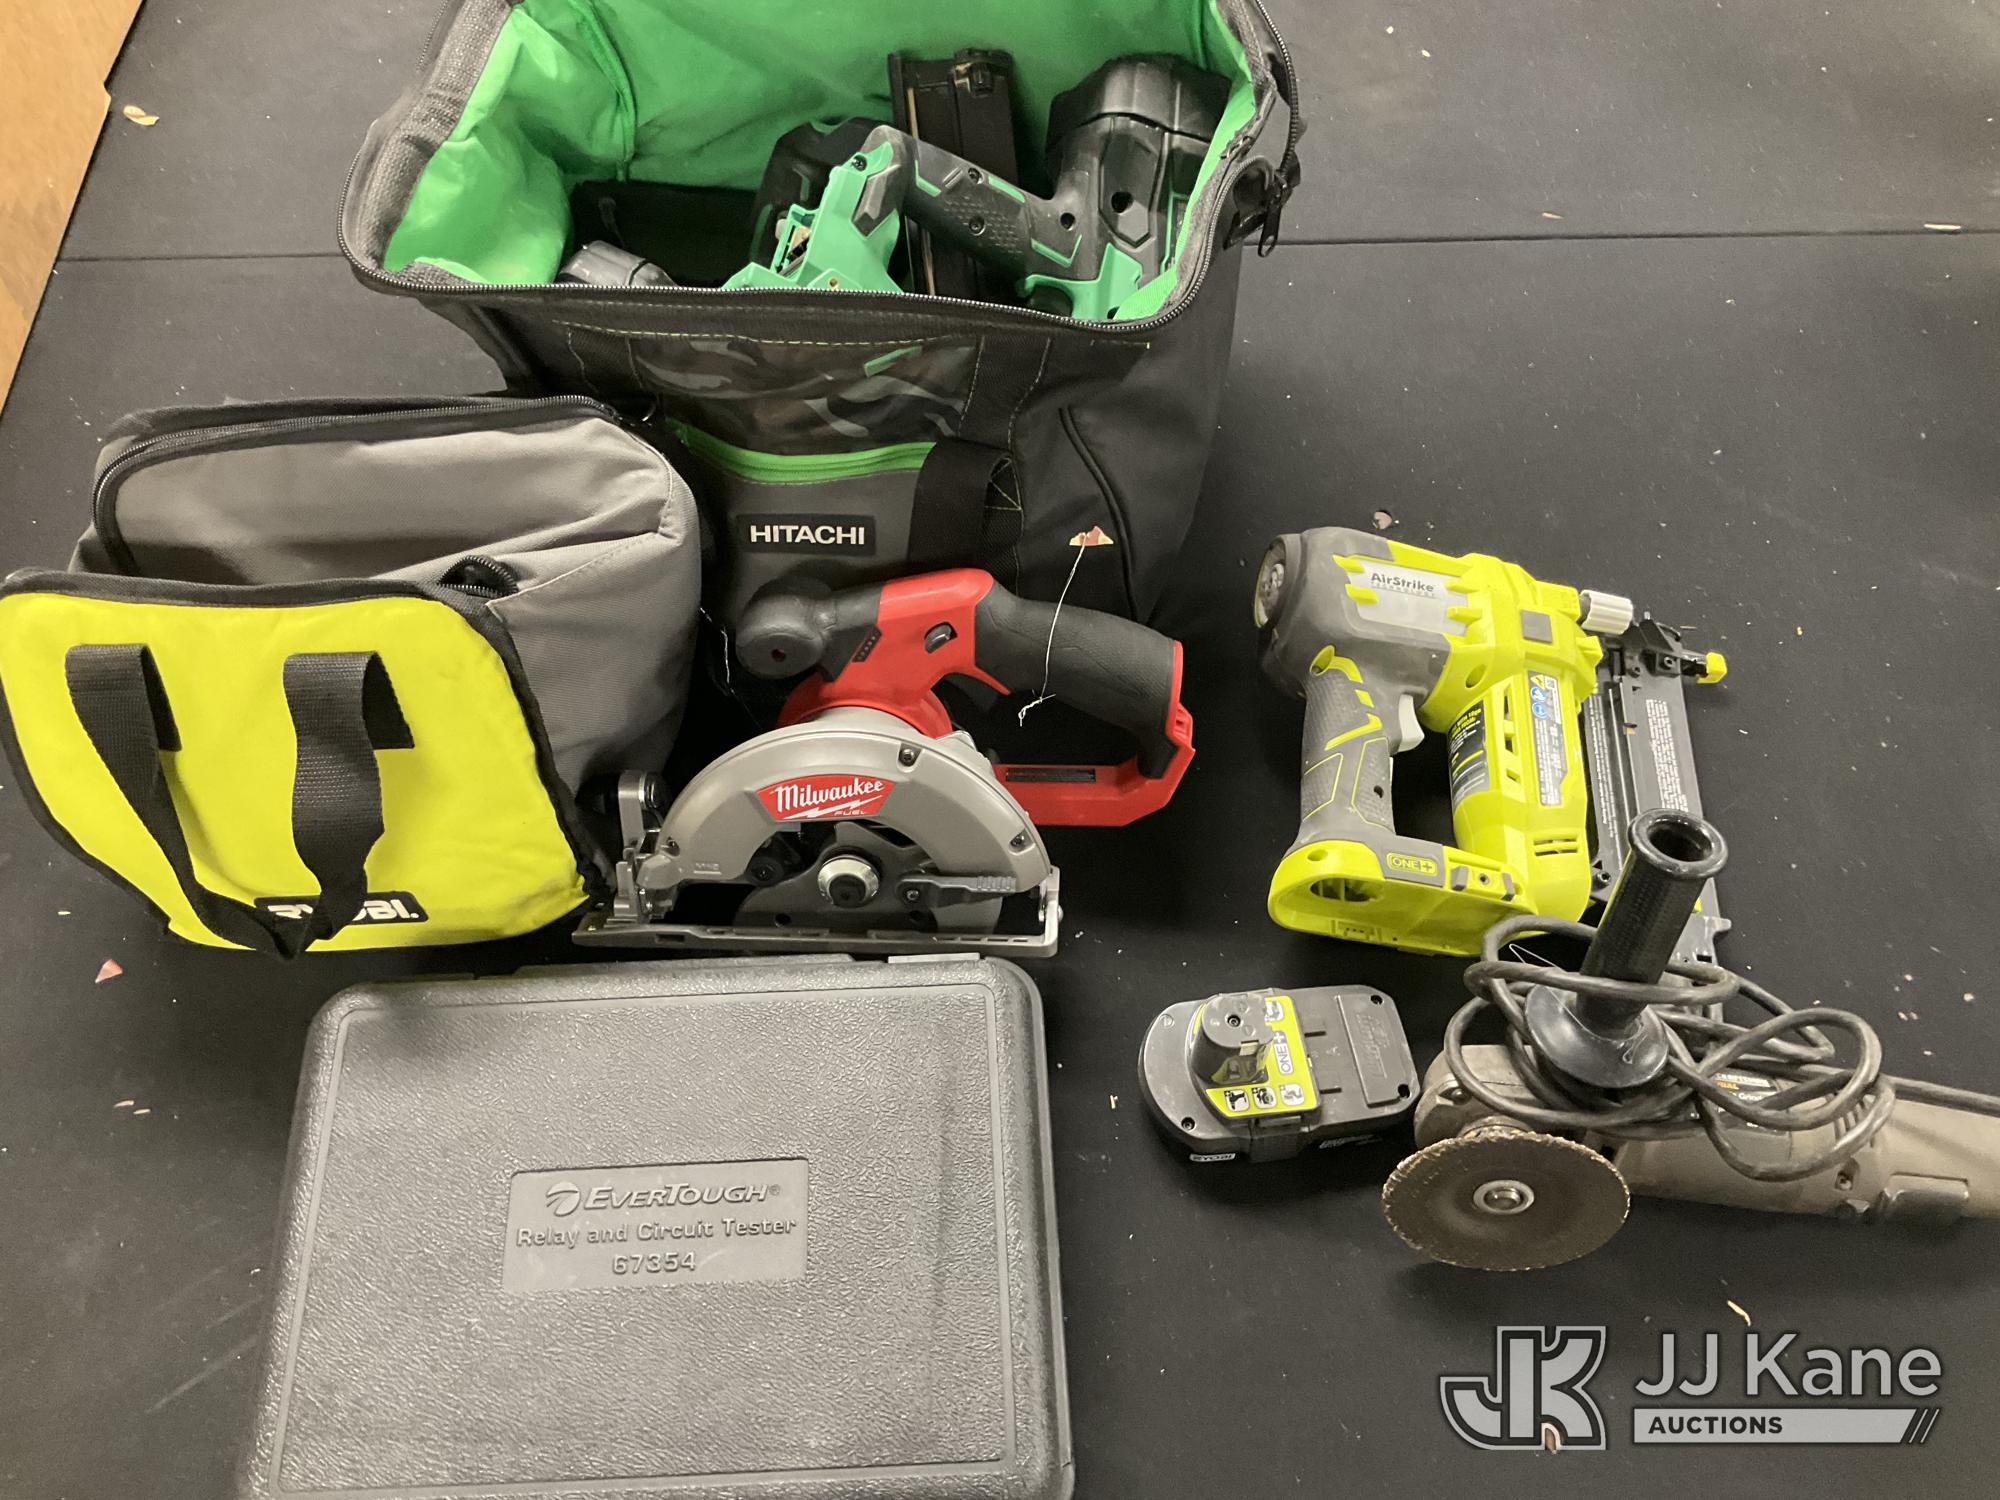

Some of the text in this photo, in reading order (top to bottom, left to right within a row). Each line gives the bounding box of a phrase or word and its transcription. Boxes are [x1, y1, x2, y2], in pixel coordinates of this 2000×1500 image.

[750, 525, 865, 545] HITACHI
[1371, 573, 1434, 592] AirStrike
[769, 777, 885, 813] Milwaukee
[1391, 857, 1433, 872] ONE+
[267, 899, 418, 921] RBI
[1273, 1031, 1291, 1073] ONE+
[516, 1215, 797, 1249] Relay and Circuit Tester
[611, 1251, 697, 1275] 67354
